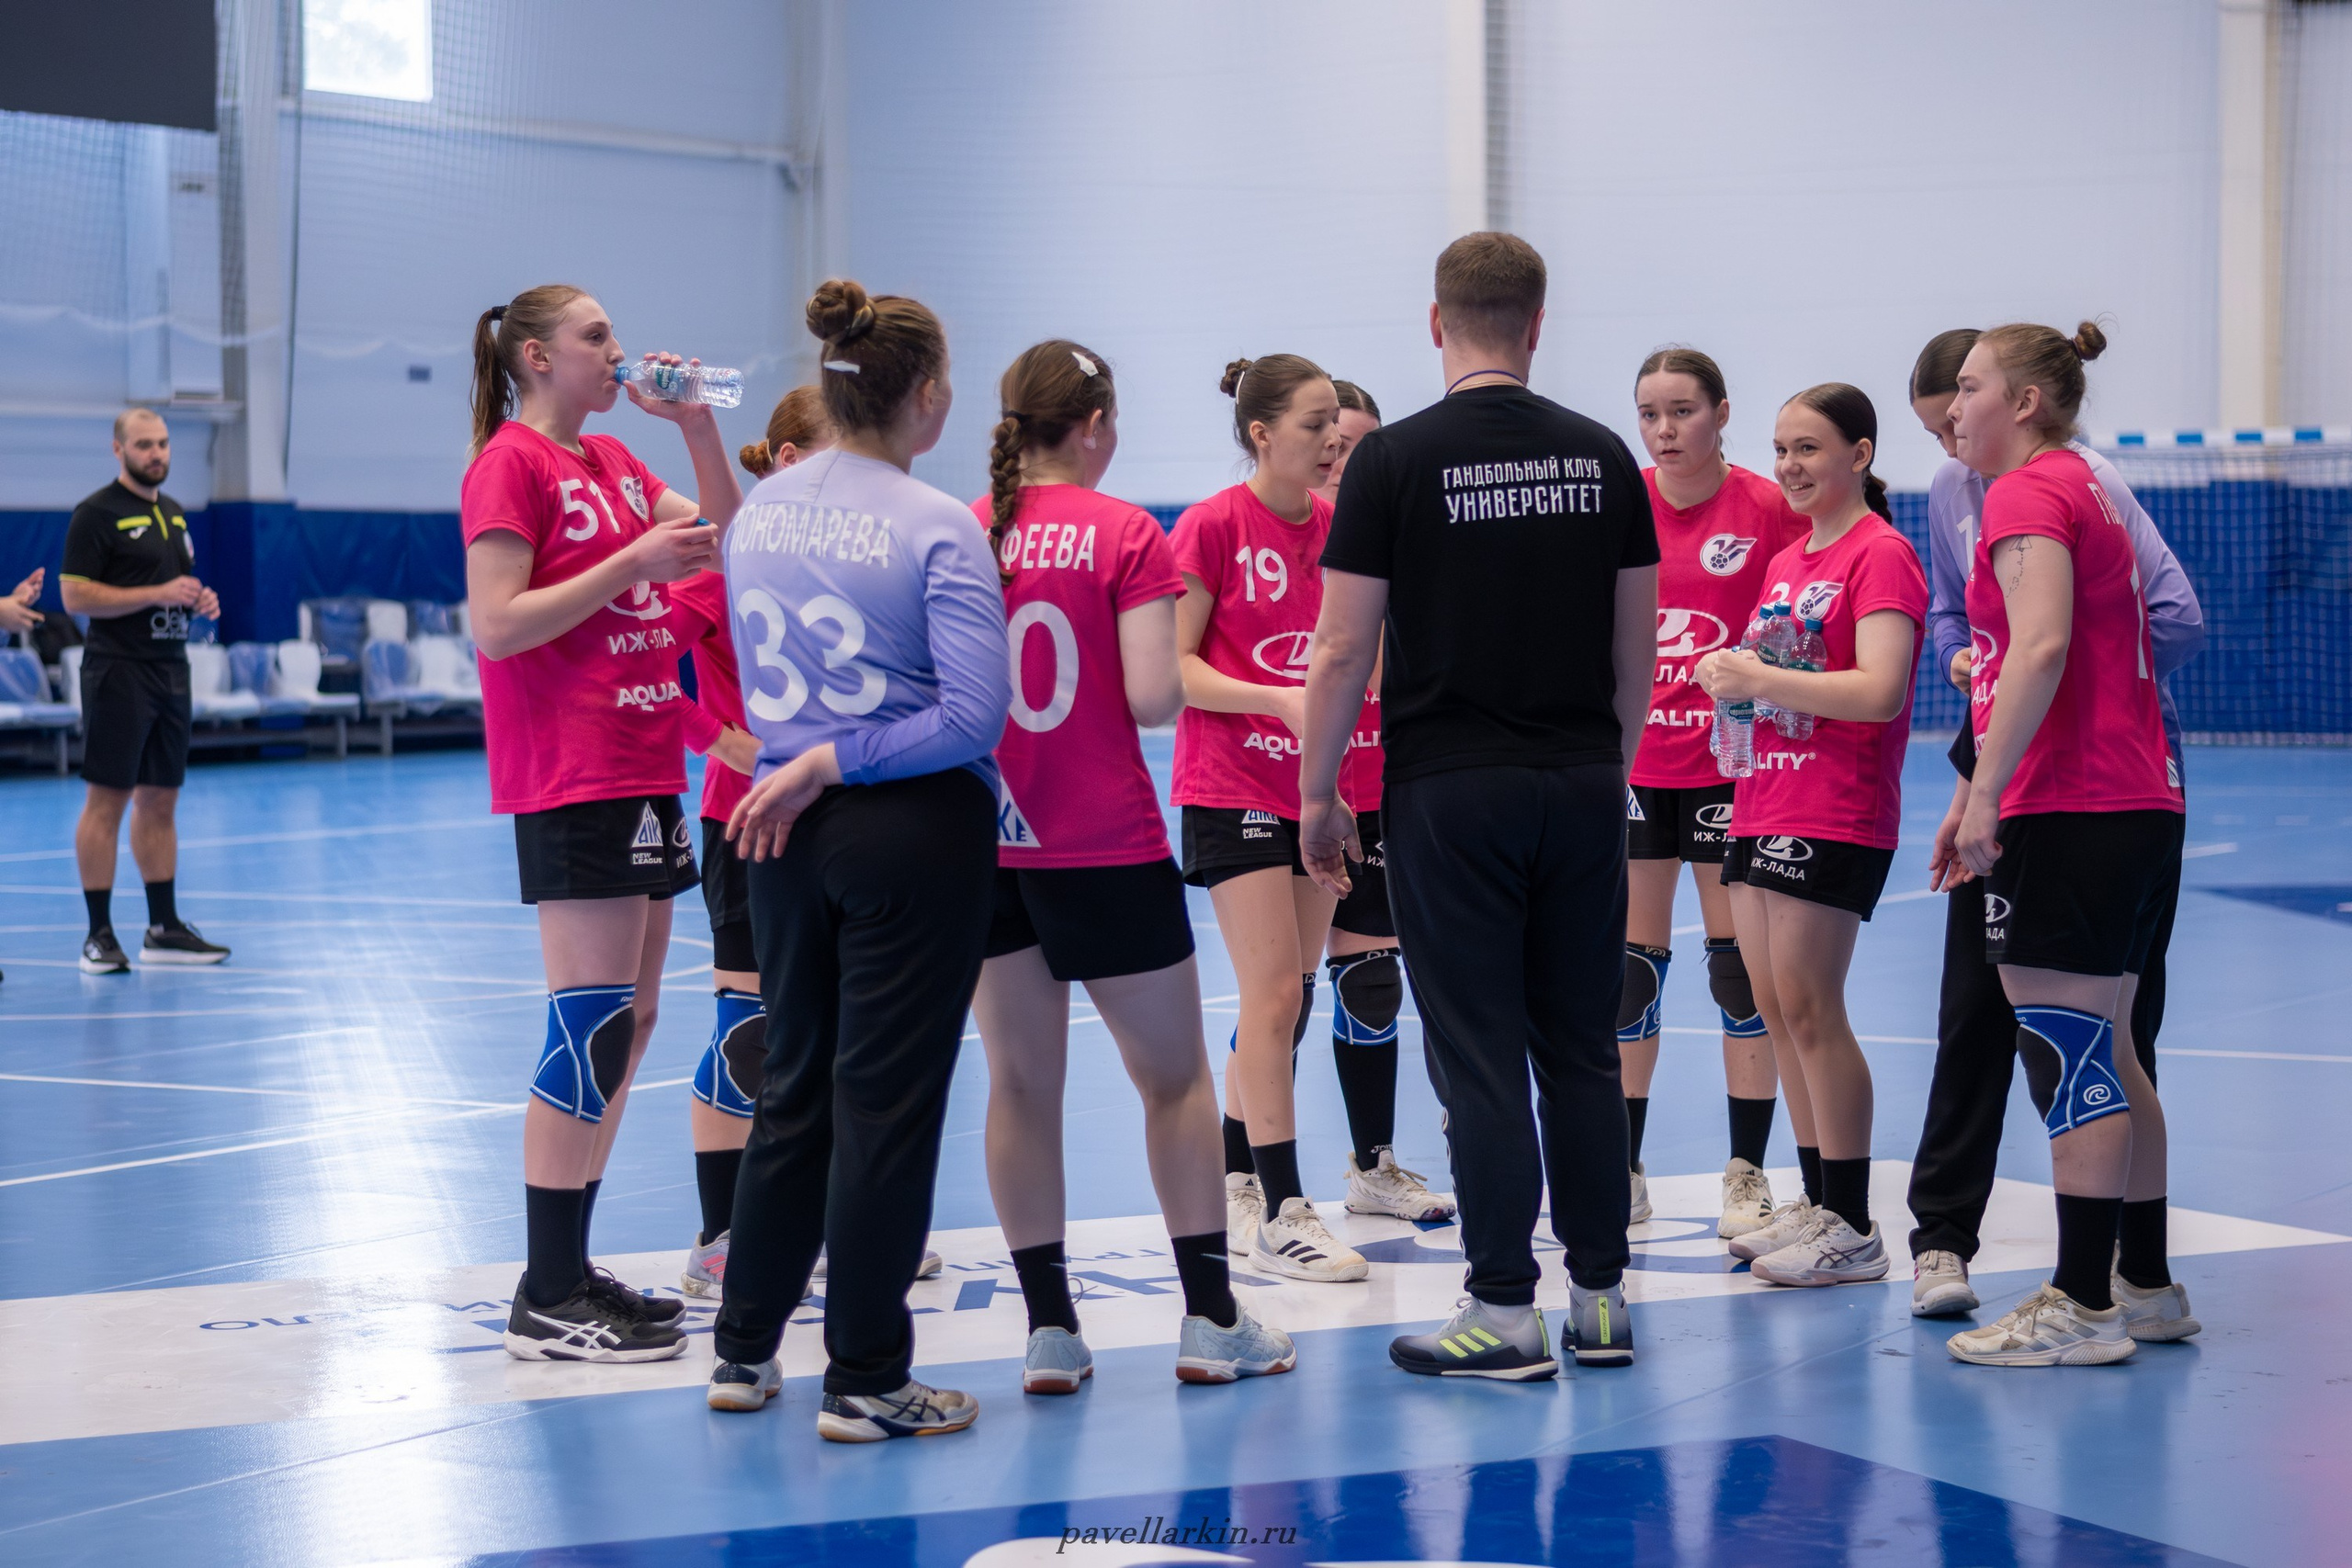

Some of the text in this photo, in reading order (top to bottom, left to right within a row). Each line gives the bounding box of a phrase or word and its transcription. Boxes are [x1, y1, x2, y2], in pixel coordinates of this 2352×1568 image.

[1442, 456, 1600, 490] ГАНДБОЛЬНЫЙ КЛУБ
[559, 478, 621, 542] 51
[1445, 483, 1602, 524] УНИВЕРСИТЕТ
[1236, 545, 1288, 603] 19
[738, 588, 888, 723] 33
[1243, 831, 1273, 840] LEAGUE
[632, 856, 663, 865] LEAGUE
